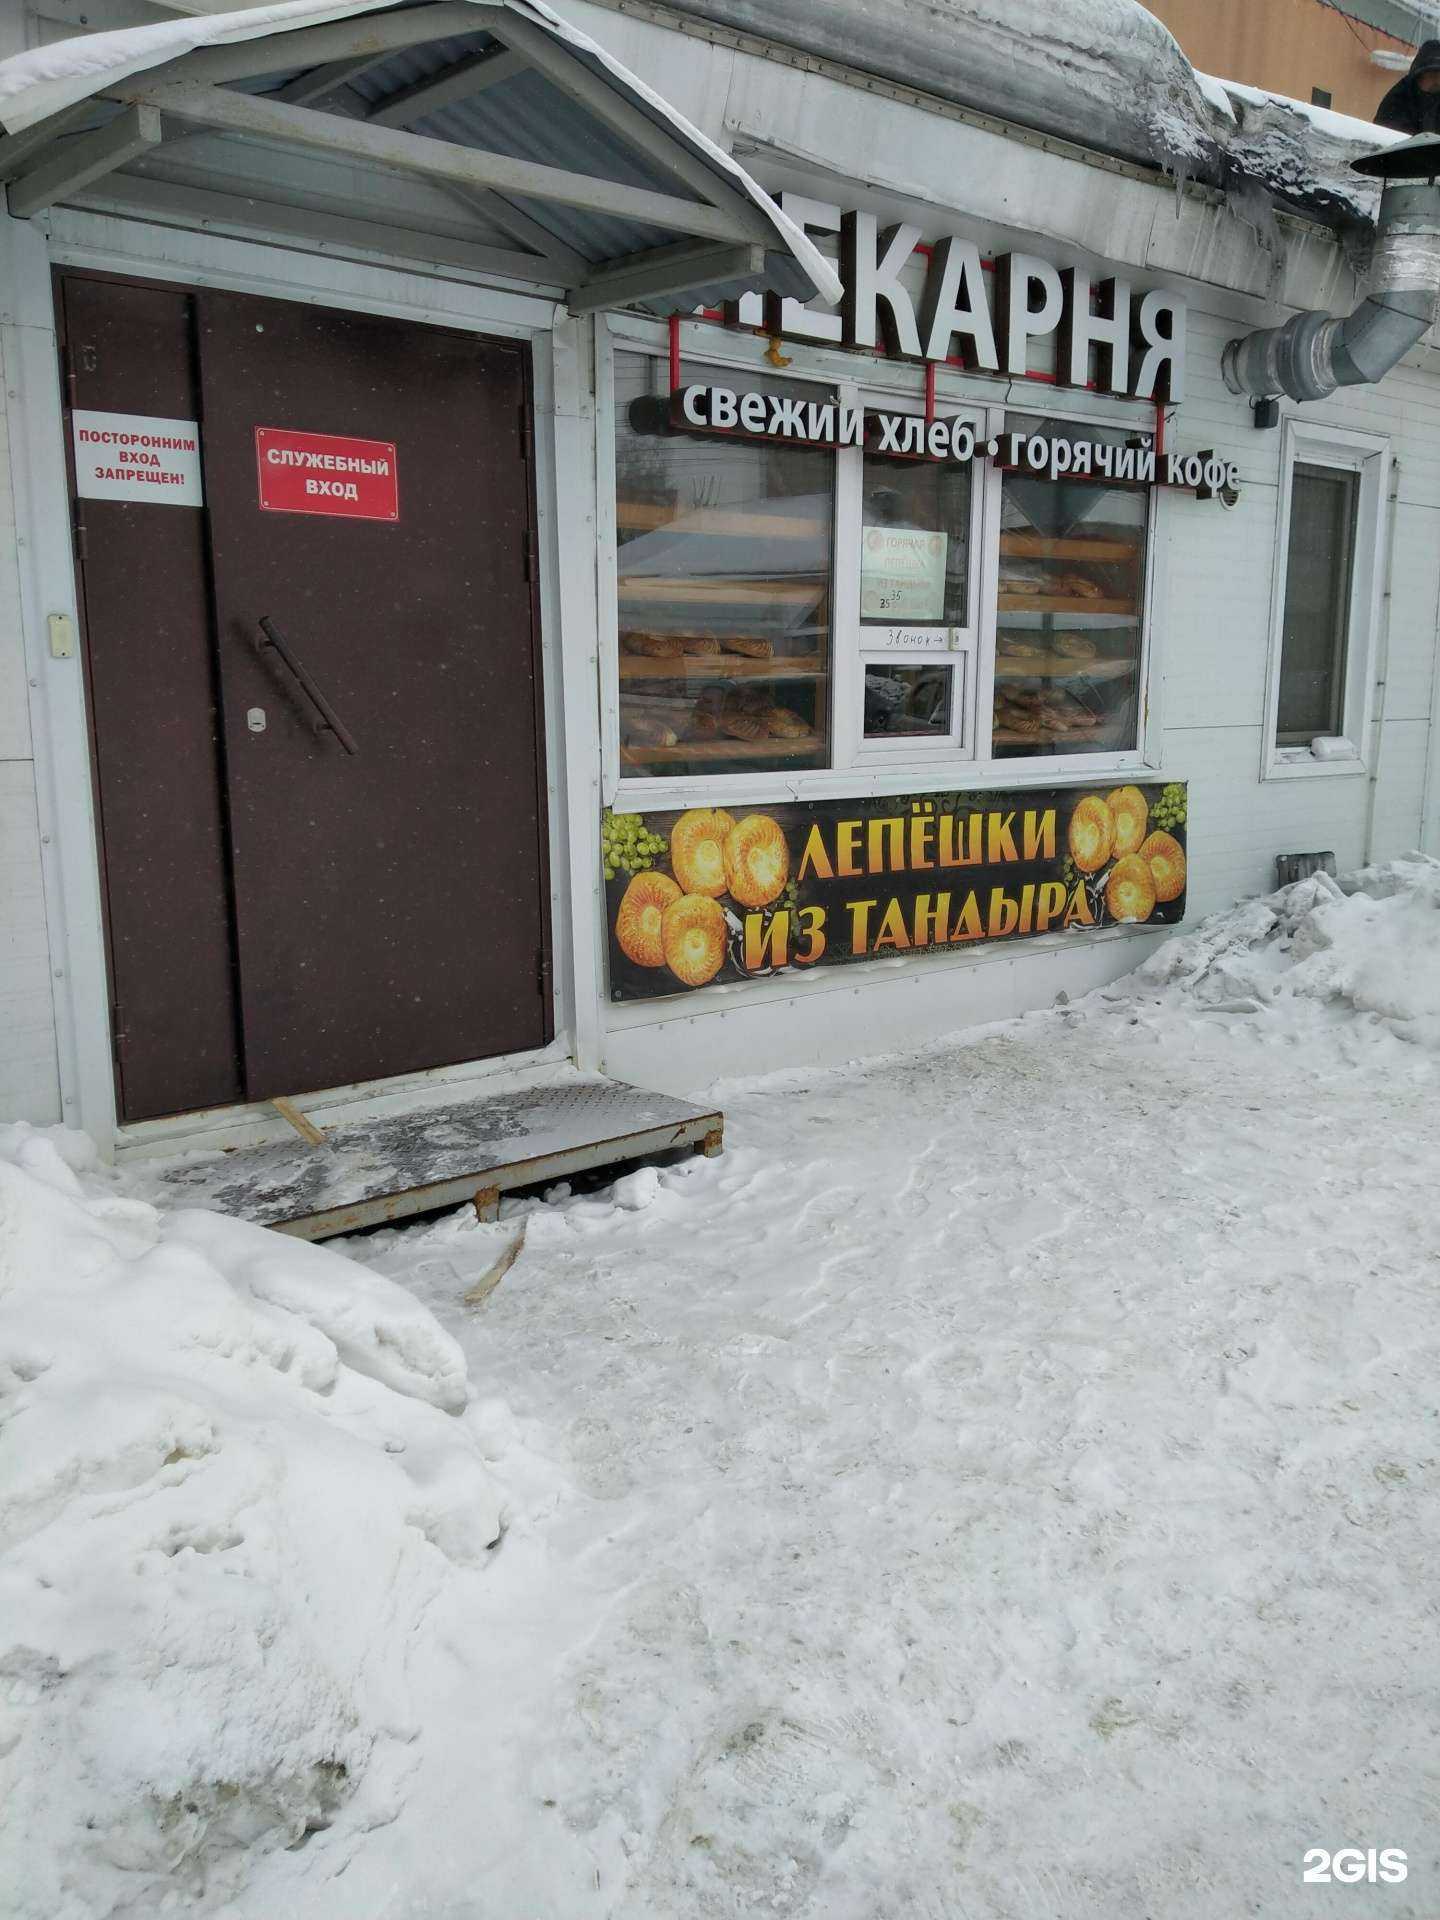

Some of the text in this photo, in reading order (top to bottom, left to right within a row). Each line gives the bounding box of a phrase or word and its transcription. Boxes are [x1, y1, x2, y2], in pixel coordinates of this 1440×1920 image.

[692, 191, 1187, 402] ЕКАРНЯ
[79, 429, 195, 451] ПОСТОРОННИМ
[119, 451, 161, 467] ВХОД
[267, 448, 389, 476] СЛУЖЕБНЫЙ
[878, 414, 975, 462] хлеб
[1011, 432, 1156, 482] горячий
[1168, 453, 1241, 498] кофе
[95, 467, 185, 485] ЗАПРЕЩЕН!
[305, 479, 359, 501] ВХОД
[797, 801, 1056, 881] ЛЕПЁШКИ
[744, 879, 1096, 970] ИЗ ТАНДЫРА
